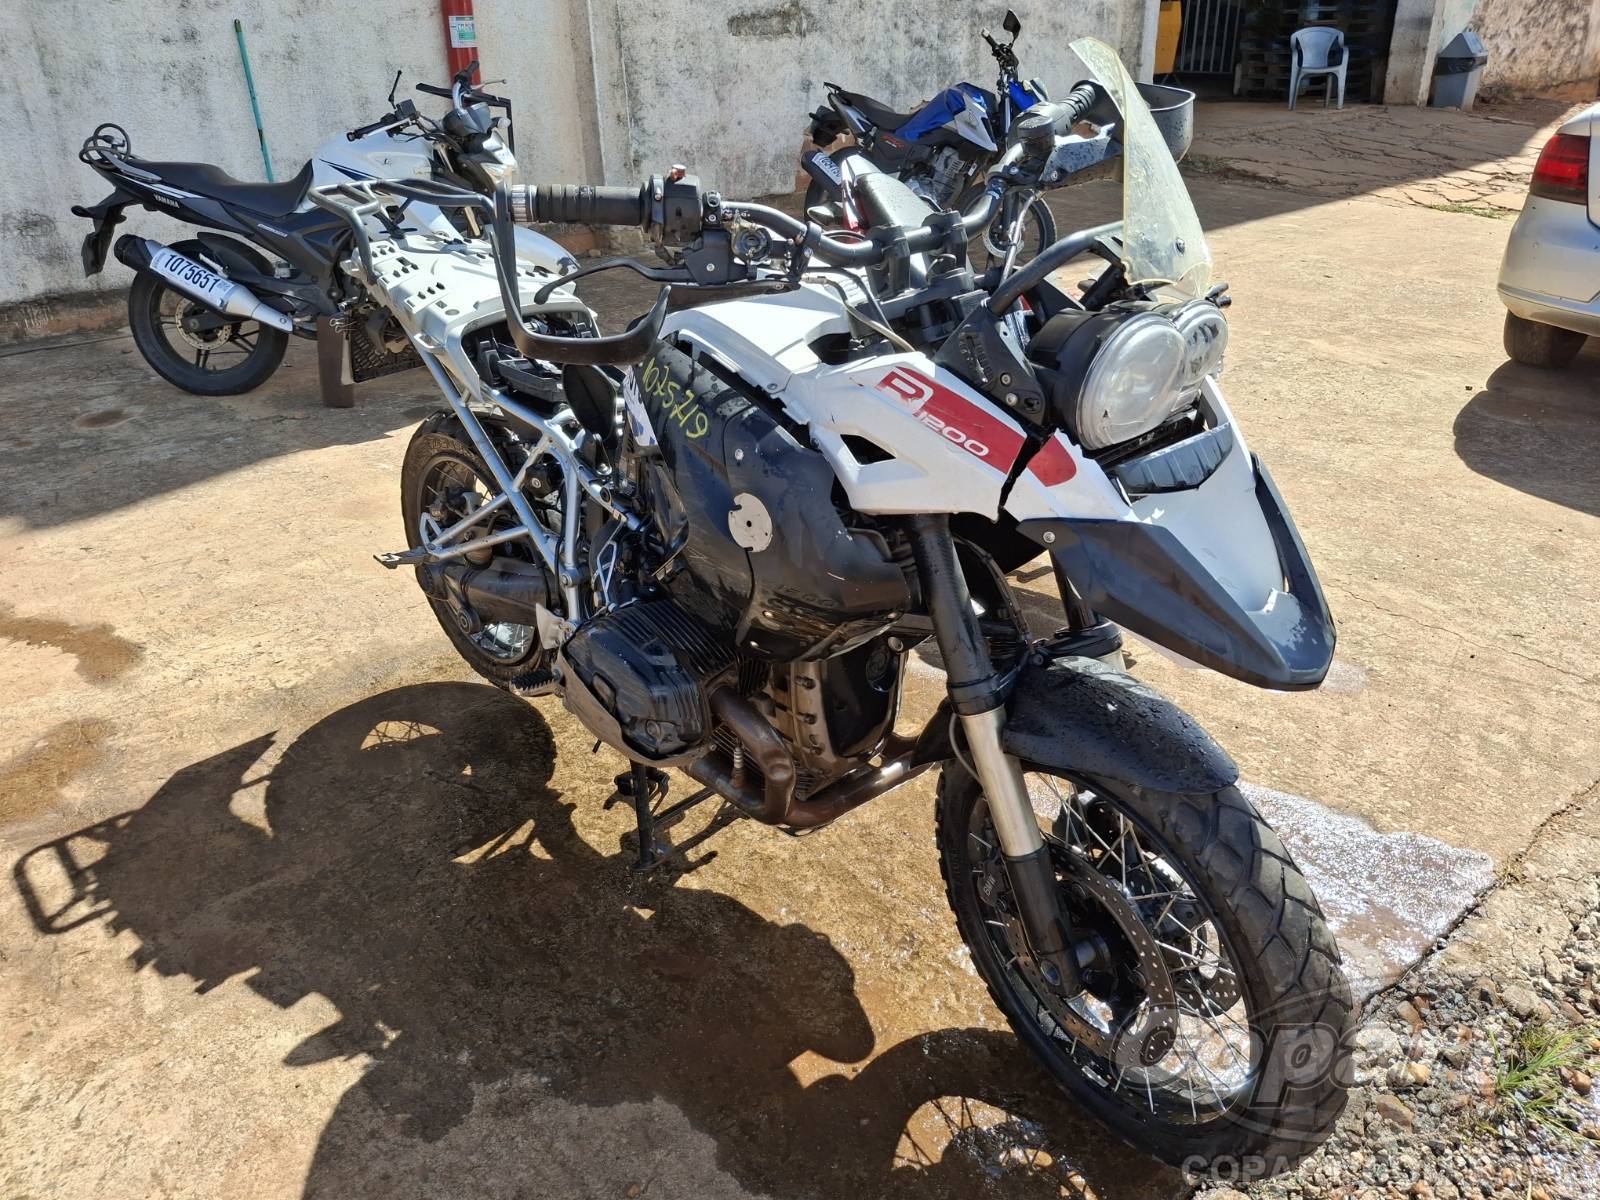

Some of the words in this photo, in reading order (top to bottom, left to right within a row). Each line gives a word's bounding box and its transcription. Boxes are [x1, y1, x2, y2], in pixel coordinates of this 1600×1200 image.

[153, 193, 180, 208] YAMAHA
[164, 254, 221, 293] 1075651
[642, 357, 708, 438] 1075719
[920, 411, 989, 456] 1200
